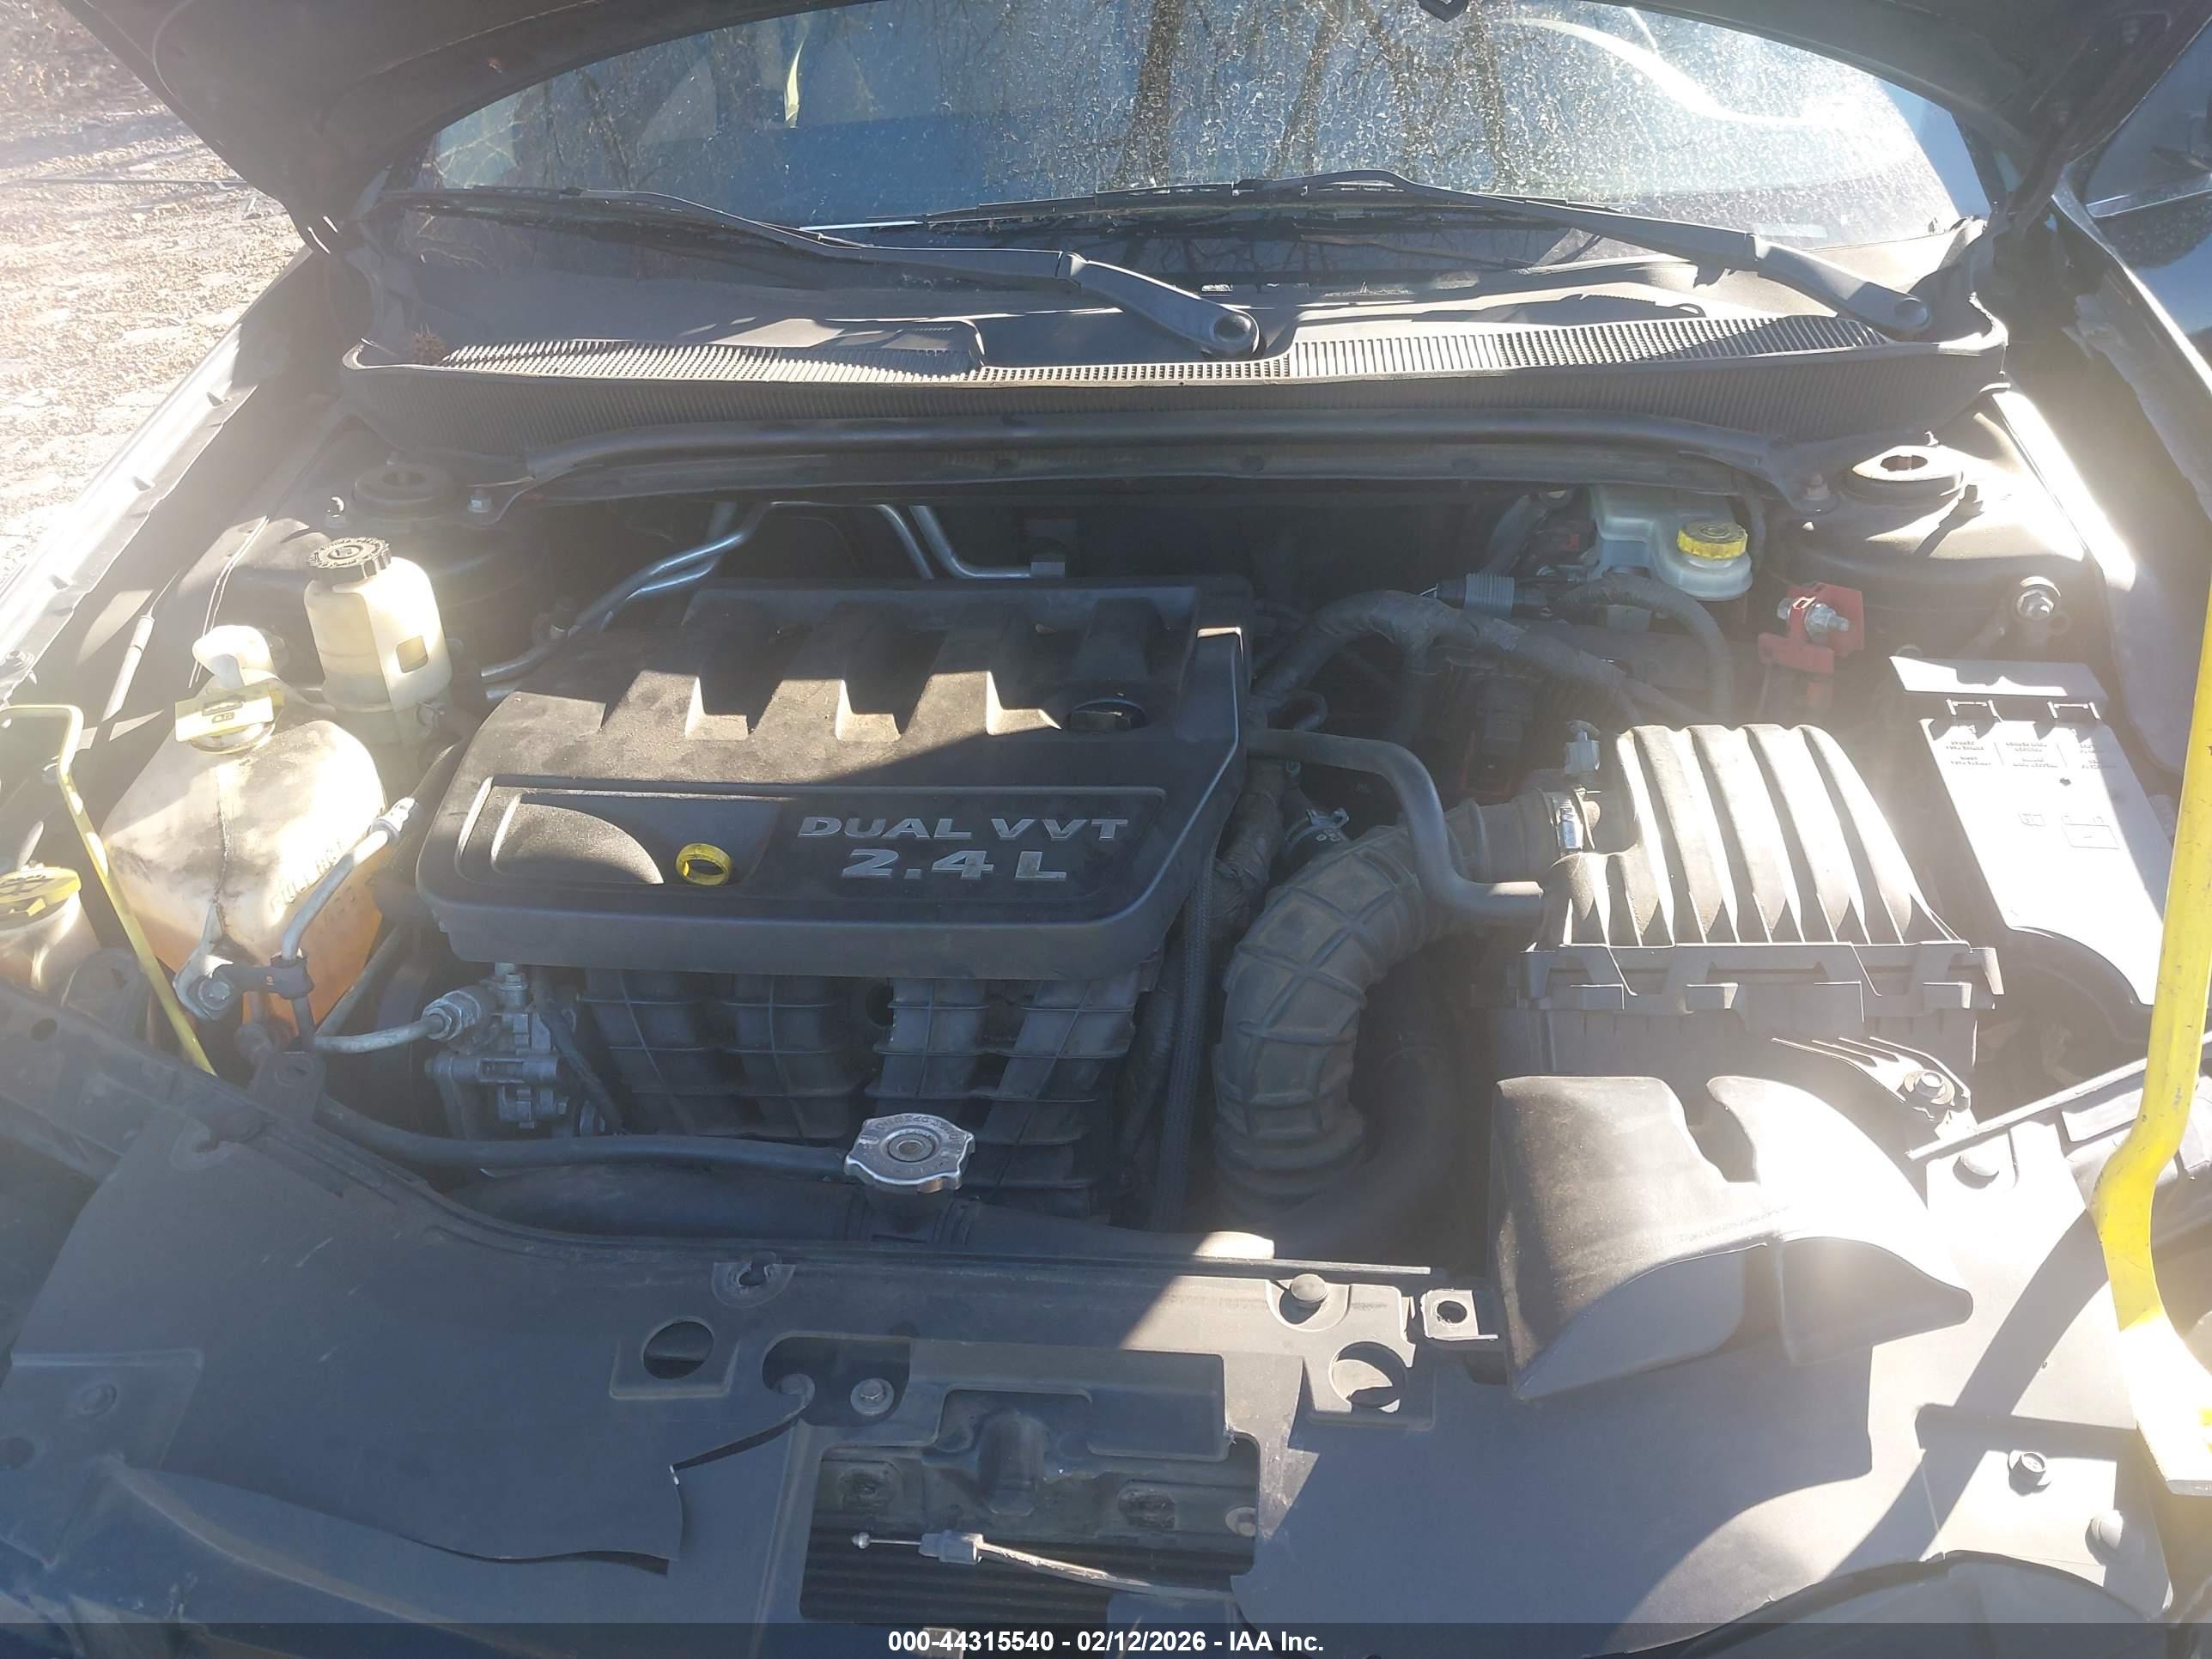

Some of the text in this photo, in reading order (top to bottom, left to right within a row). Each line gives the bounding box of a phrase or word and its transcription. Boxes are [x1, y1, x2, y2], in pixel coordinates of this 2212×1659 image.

[797, 817, 1129, 840] DUAL VVT
[842, 848, 1067, 880] 2.4 L
